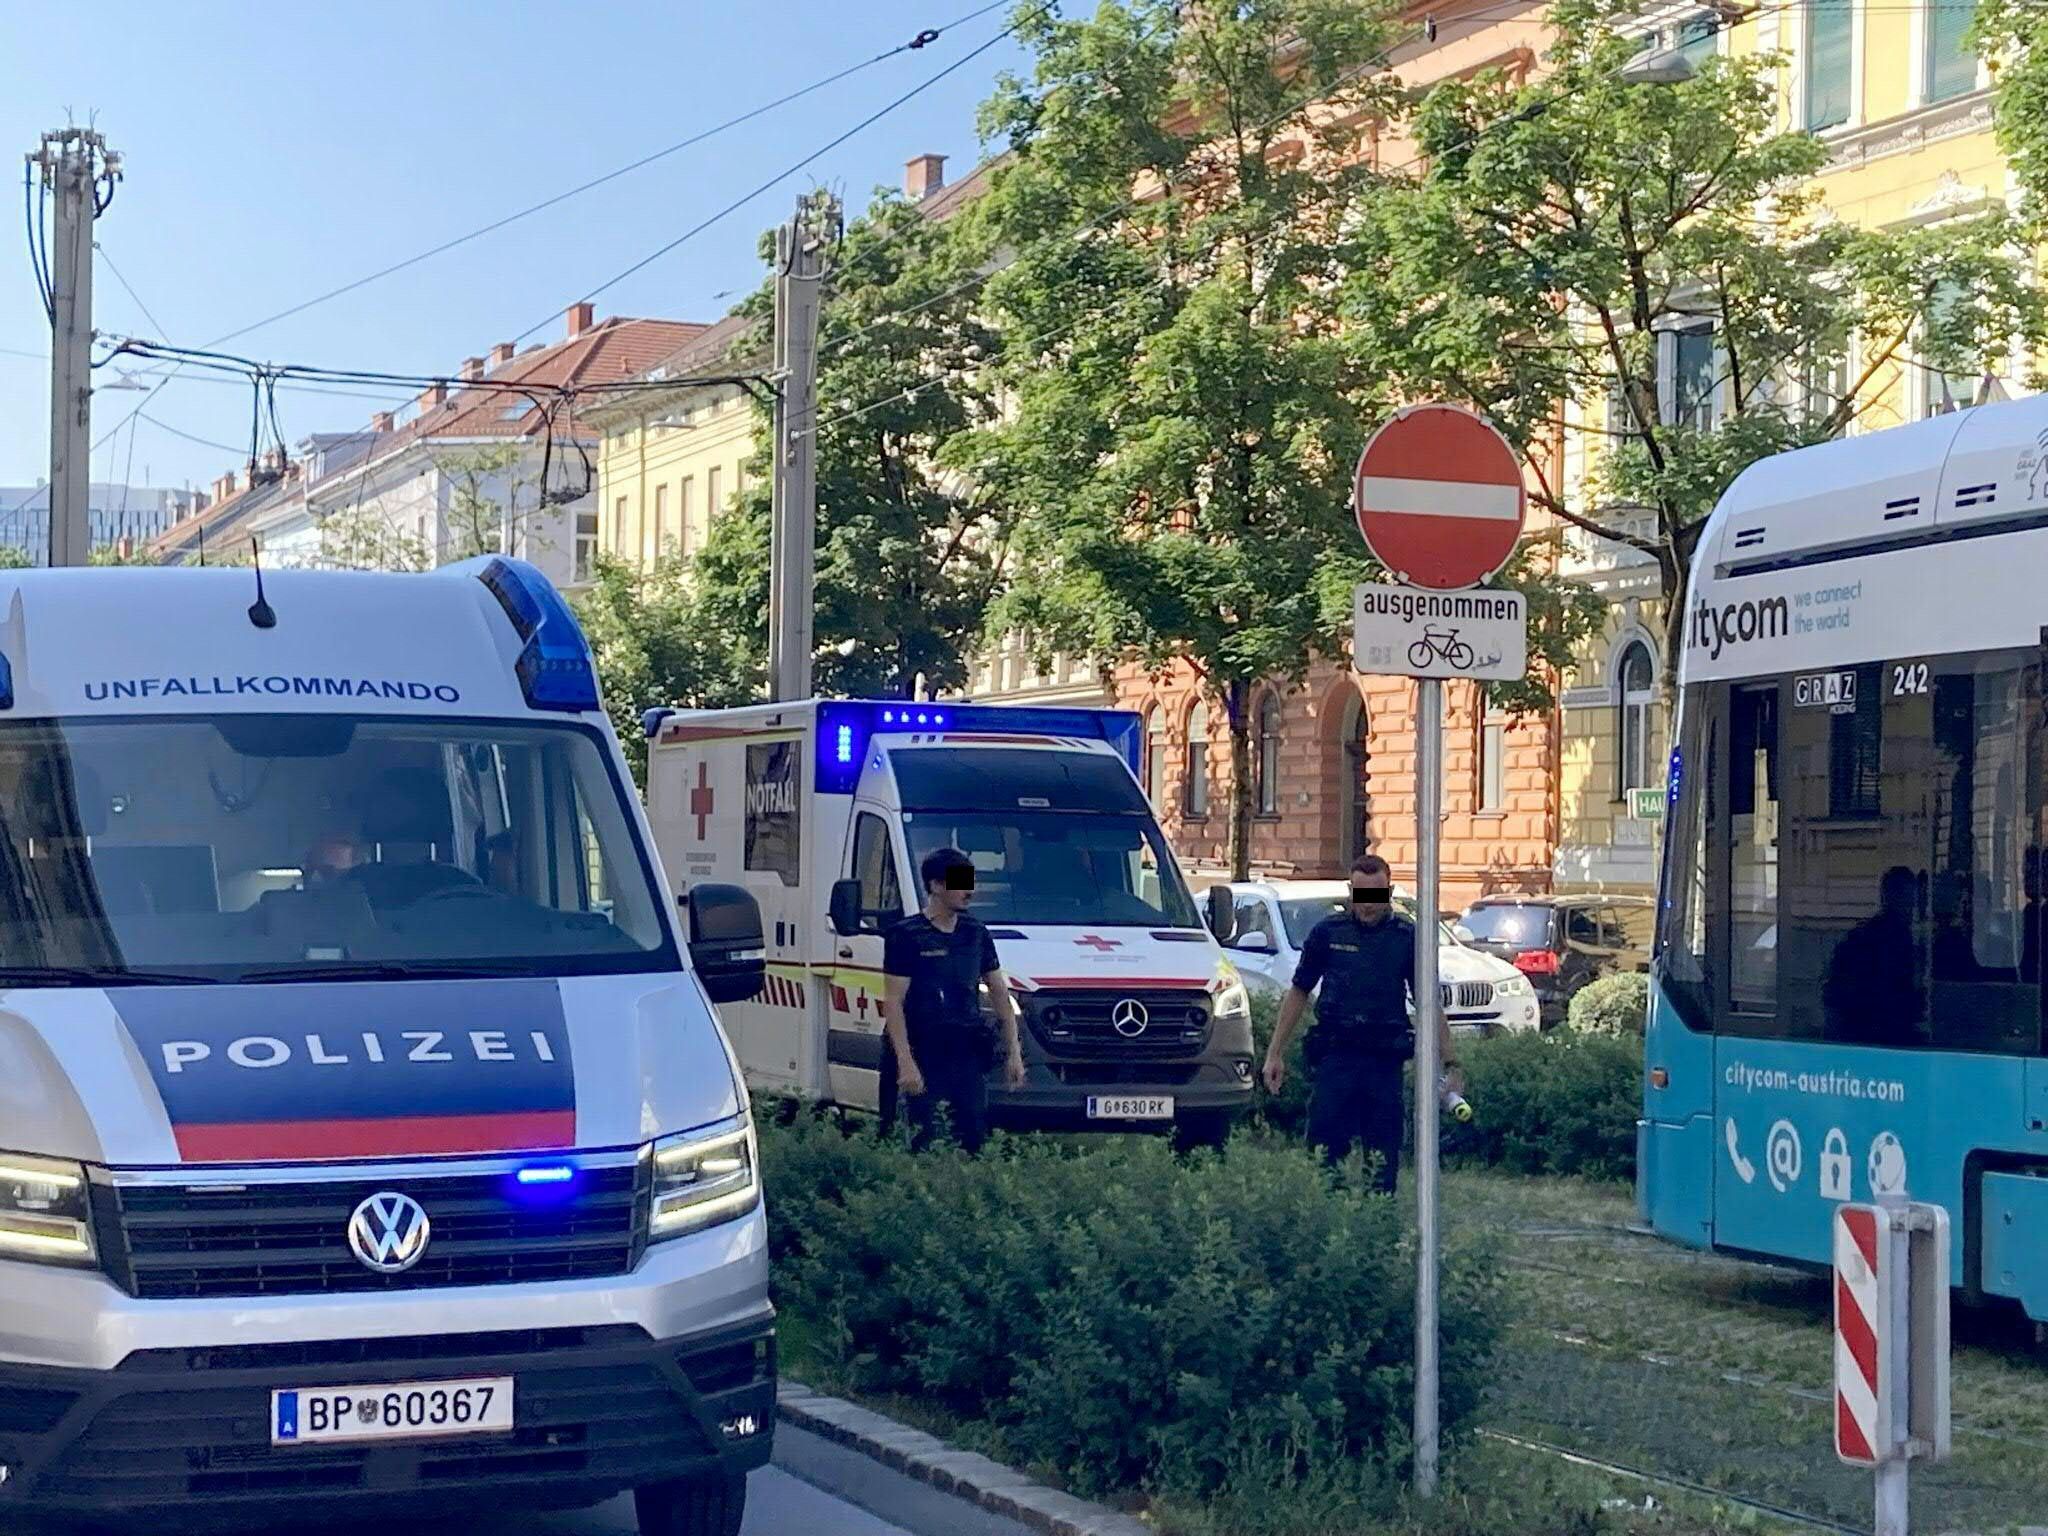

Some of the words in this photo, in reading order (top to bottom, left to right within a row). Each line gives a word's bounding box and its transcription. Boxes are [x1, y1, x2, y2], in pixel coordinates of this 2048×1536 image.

[1364, 593, 1519, 623] ausgenommen
[1793, 590, 1811, 607] we
[1815, 580, 1862, 605] connect
[1687, 588, 1788, 660] itycom
[1794, 614, 1813, 634] the
[1816, 608, 1850, 630] world
[85, 676, 460, 703] UNFALLKOMMANDO
[1796, 673, 1854, 703] GRAZ
[1893, 663, 1928, 696] 242
[746, 781, 796, 814] NOTFALL
[161, 1031, 555, 1073] POLIZEI
[1725, 1061, 1904, 1102] citycom-austria.com
[309, 1396, 352, 1431] BP
[383, 1387, 494, 1427] 60367
